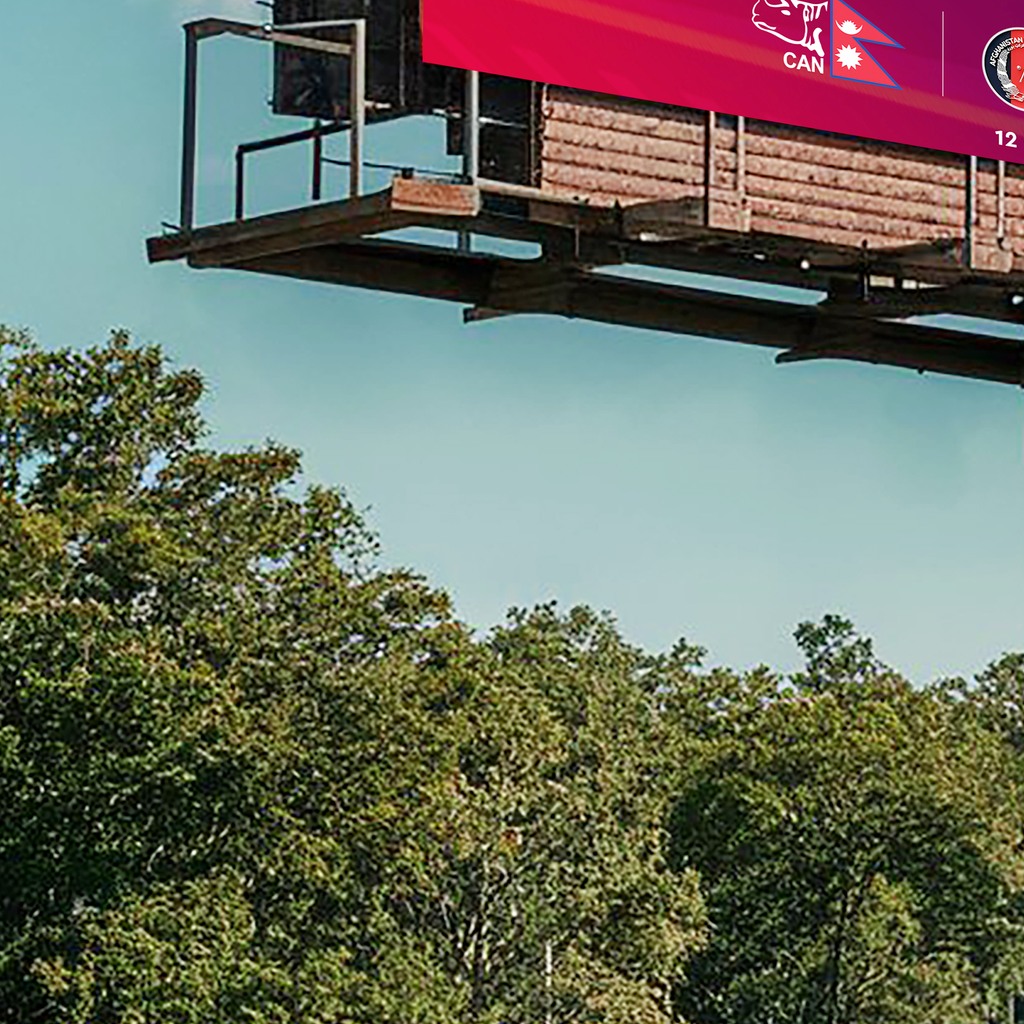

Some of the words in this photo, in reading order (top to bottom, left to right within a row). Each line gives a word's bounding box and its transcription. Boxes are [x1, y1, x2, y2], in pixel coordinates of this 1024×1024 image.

[783, 51, 824, 75] CAN
[989, 37, 1023, 67] AFGHANISTAN
[994, 130, 1017, 148] 12
